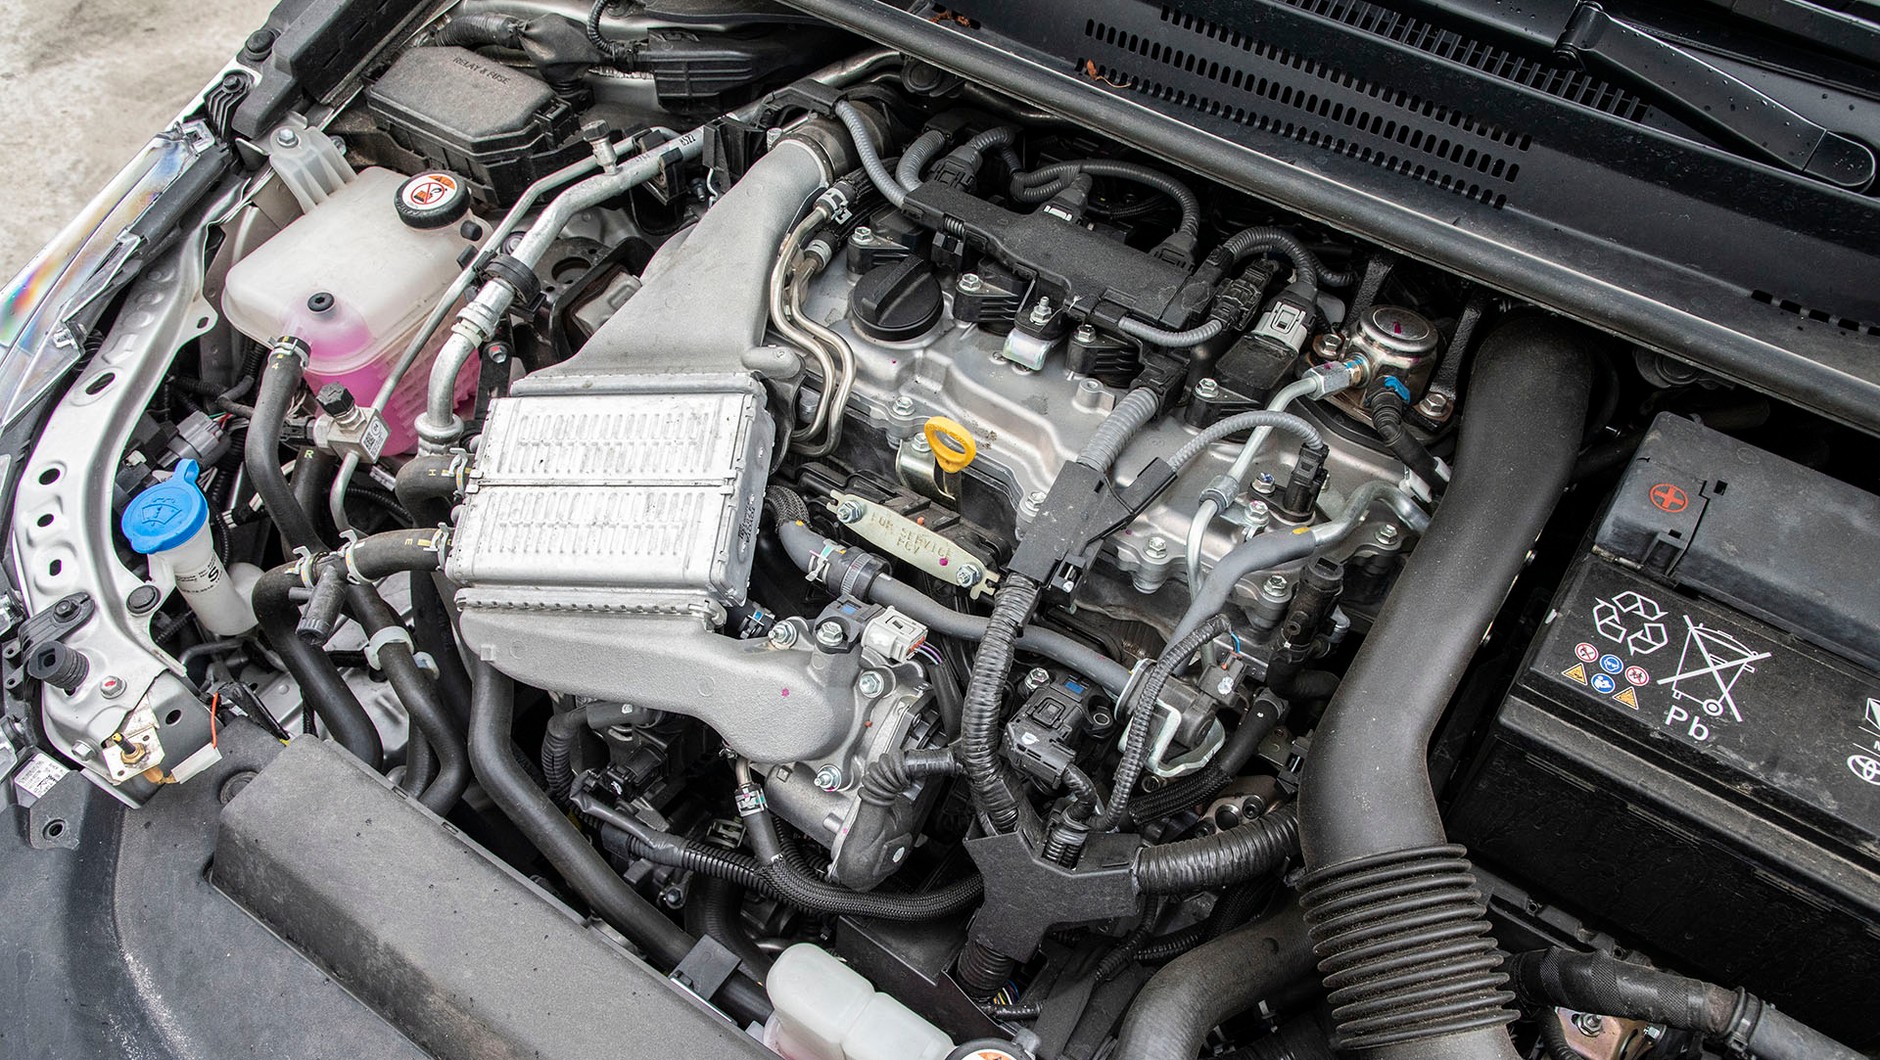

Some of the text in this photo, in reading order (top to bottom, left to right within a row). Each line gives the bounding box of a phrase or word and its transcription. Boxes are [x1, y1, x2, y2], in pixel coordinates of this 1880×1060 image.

[453, 56, 481, 72] RELAY
[487, 71, 511, 85] FUSE
[304, 449, 314, 459] R
[871, 512, 953, 559] FOR SERVICE
[1665, 704, 1710, 741] Pb
